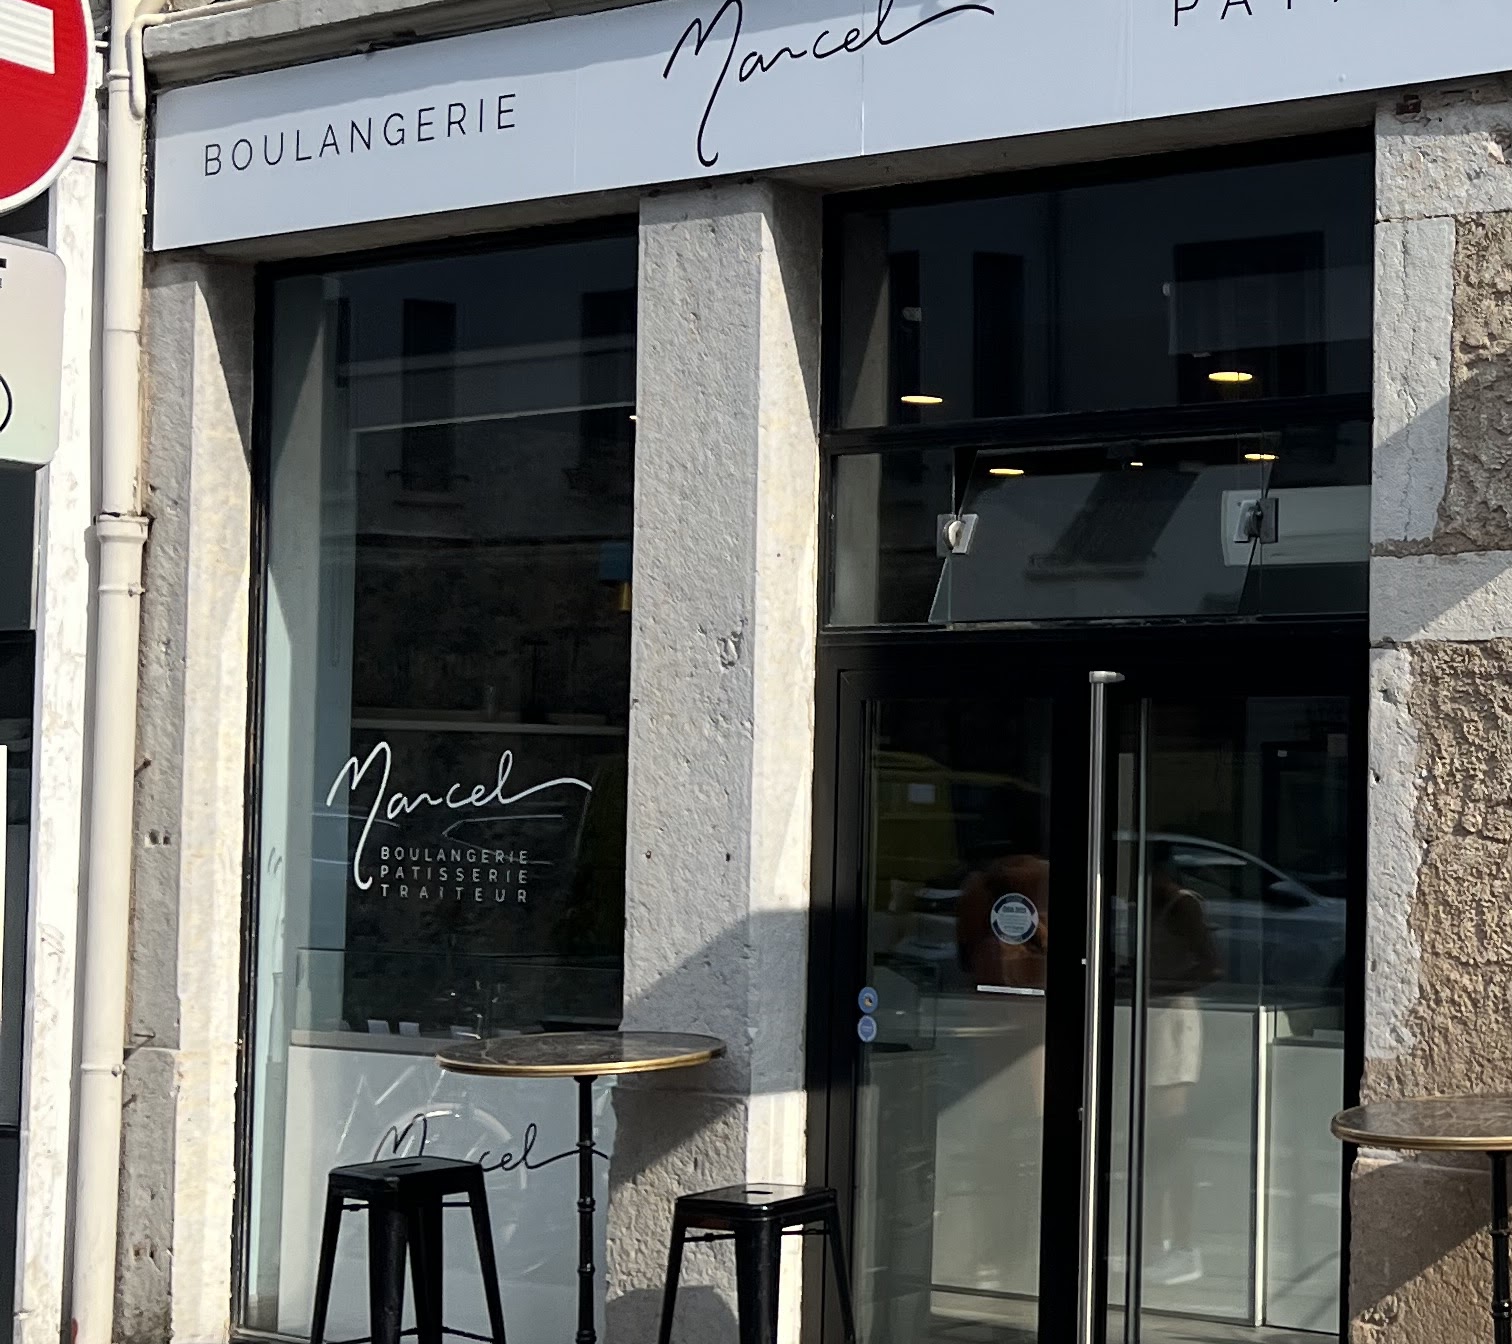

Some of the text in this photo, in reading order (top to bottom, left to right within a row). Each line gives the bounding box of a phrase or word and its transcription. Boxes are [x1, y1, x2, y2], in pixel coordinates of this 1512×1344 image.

[203, 92, 518, 177] BOULANGERIE
[326, 741, 593, 890] Marcel
[380, 846, 529, 864] BOULANGERIE
[380, 865, 529, 884] PATISSERIE
[380, 884, 528, 903] TRAITEUR
